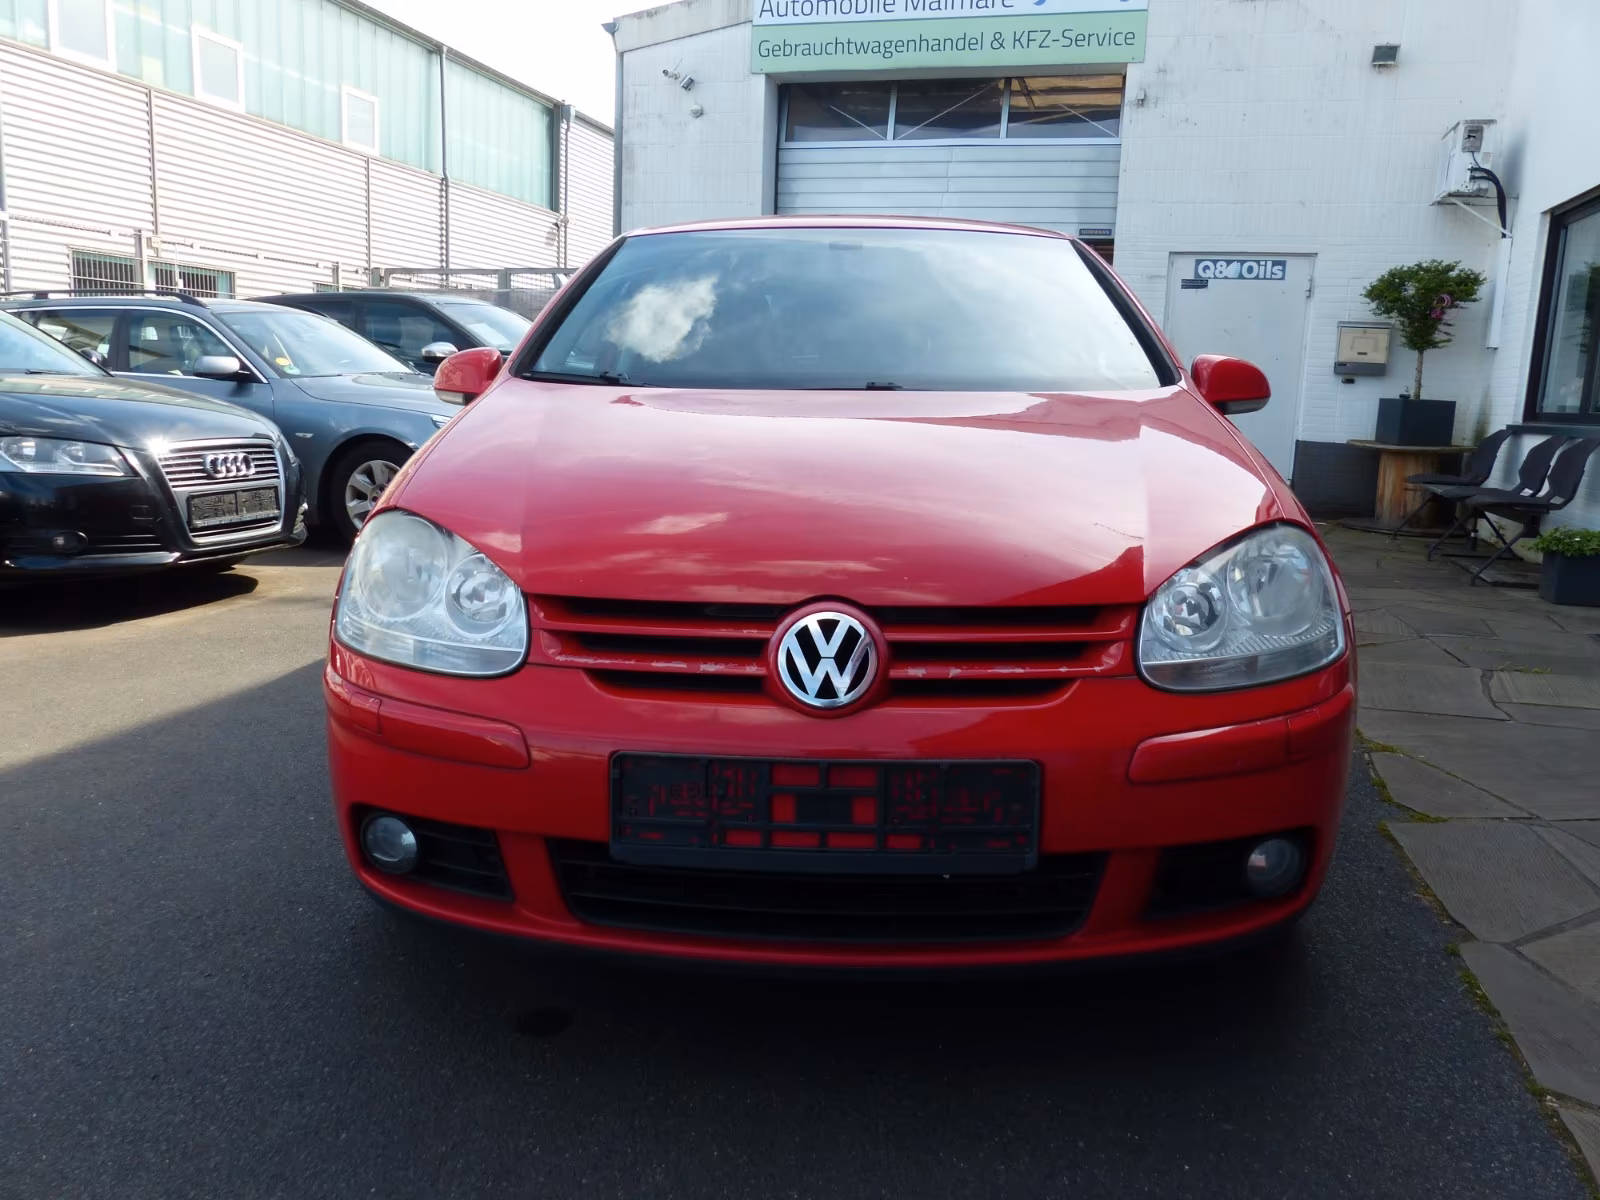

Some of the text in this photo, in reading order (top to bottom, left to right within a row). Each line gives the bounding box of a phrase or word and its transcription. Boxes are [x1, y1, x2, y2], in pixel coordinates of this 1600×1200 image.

[758, 0, 896, 18] Automobile
[758, 27, 1136, 59] Gebrauchtwagenhandel & KFZ-Service
[1241, 260, 1283, 279] Oils
[779, 612, 877, 706] VW
